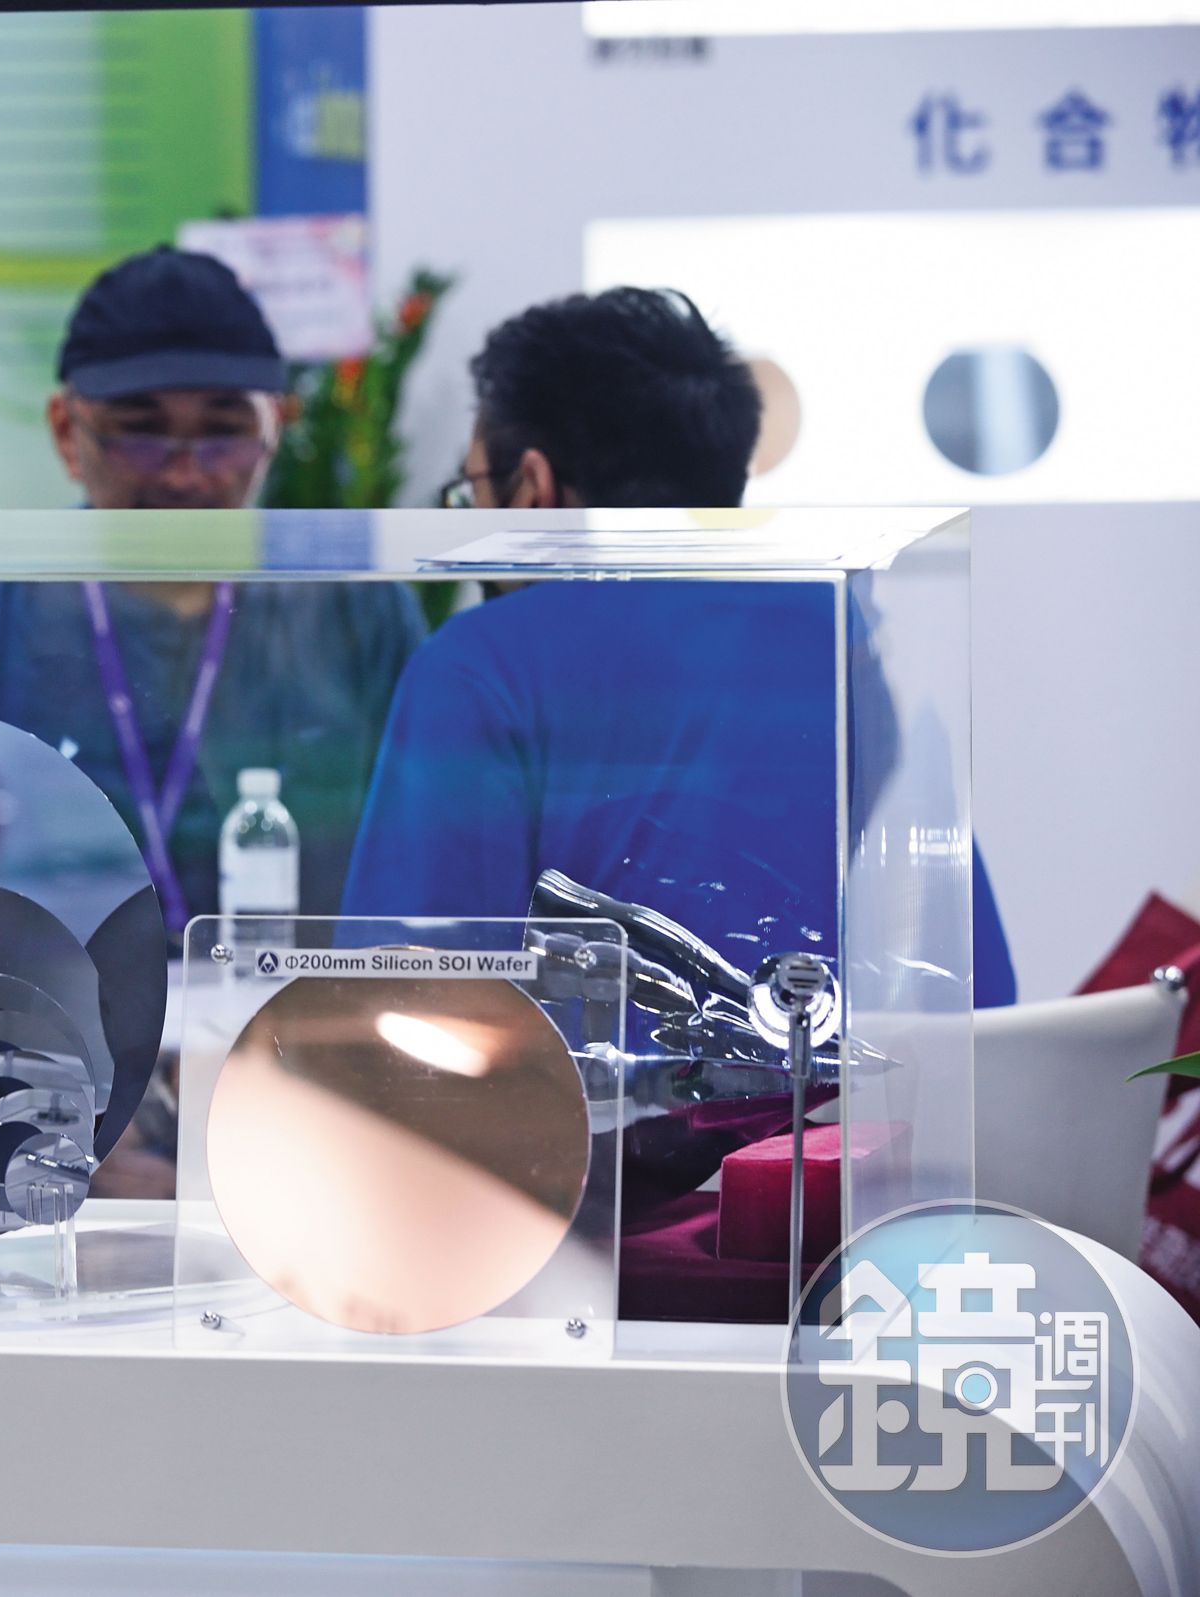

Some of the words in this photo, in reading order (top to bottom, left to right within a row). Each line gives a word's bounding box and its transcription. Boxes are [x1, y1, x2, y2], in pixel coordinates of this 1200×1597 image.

[372, 955, 433, 971] Silicon
[438, 956, 471, 971] SOI
[477, 956, 532, 972] Wafer
